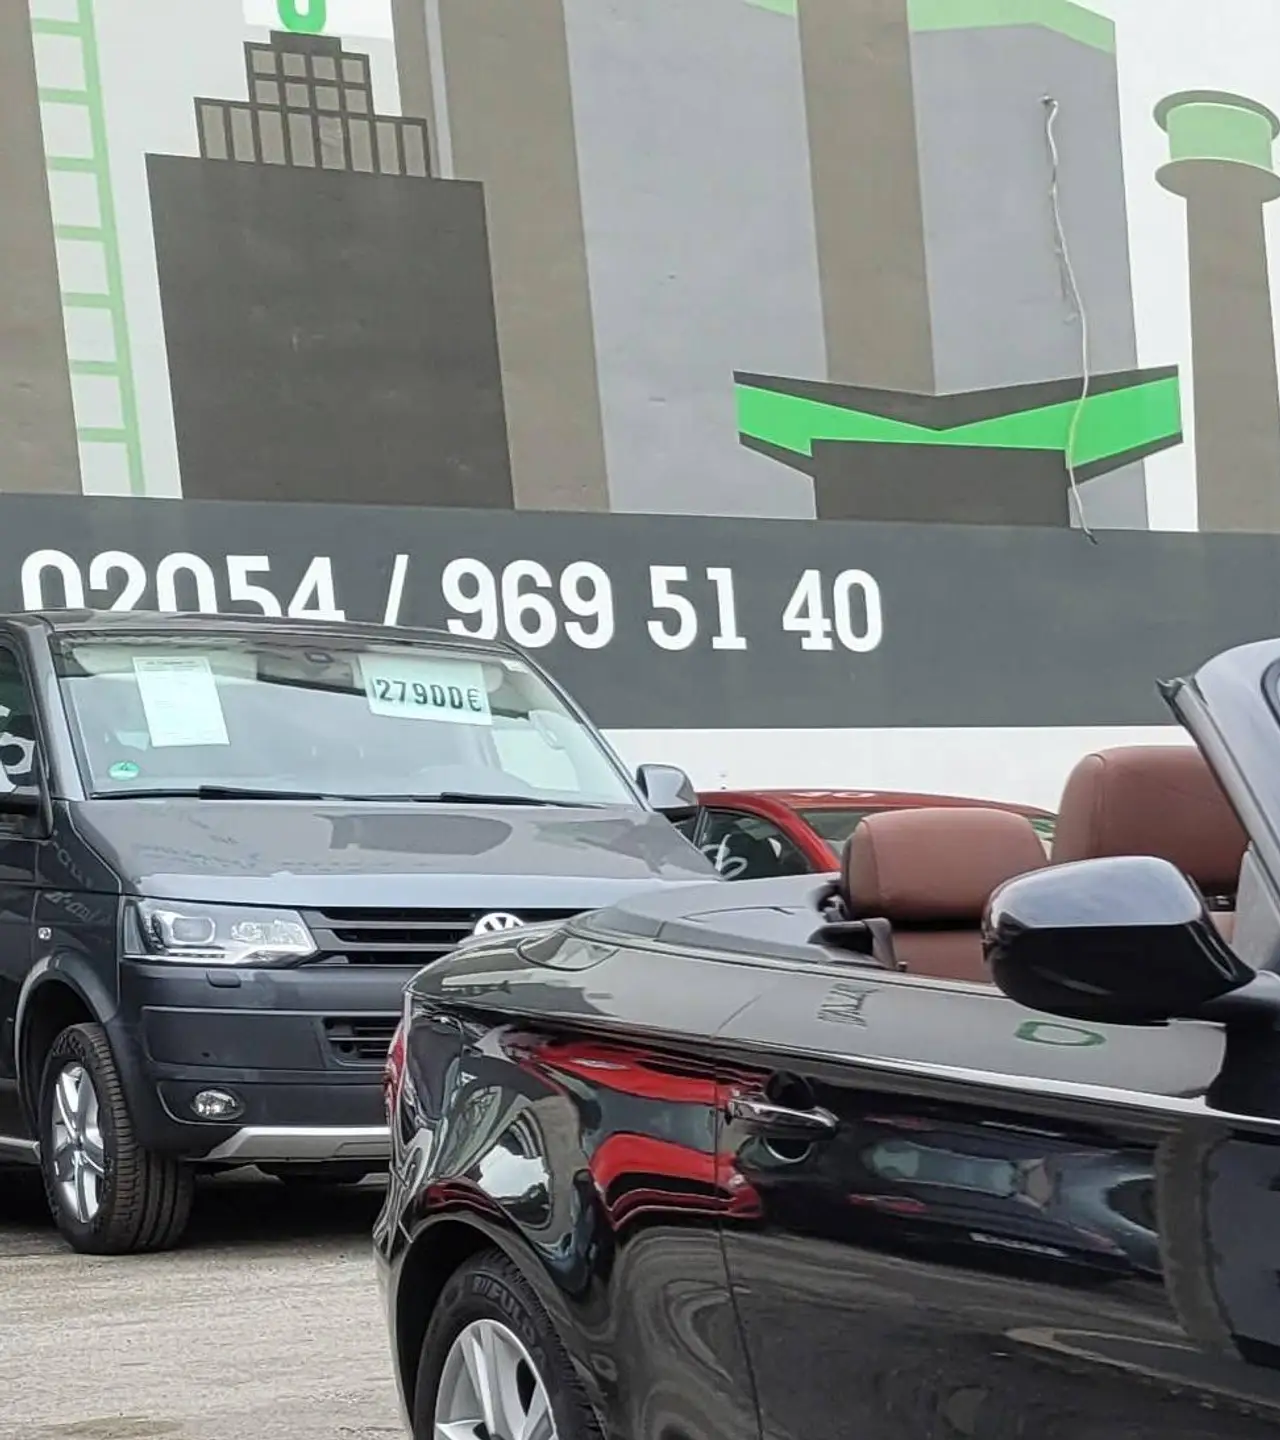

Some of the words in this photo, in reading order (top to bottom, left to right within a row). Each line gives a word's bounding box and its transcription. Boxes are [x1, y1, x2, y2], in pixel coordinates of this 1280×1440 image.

[21, 549, 346, 622] 02054
[442, 557, 614, 650] 969
[646, 565, 748, 651] 51
[782, 569, 883, 652] 40
[376, 679, 482, 712] 27900€
